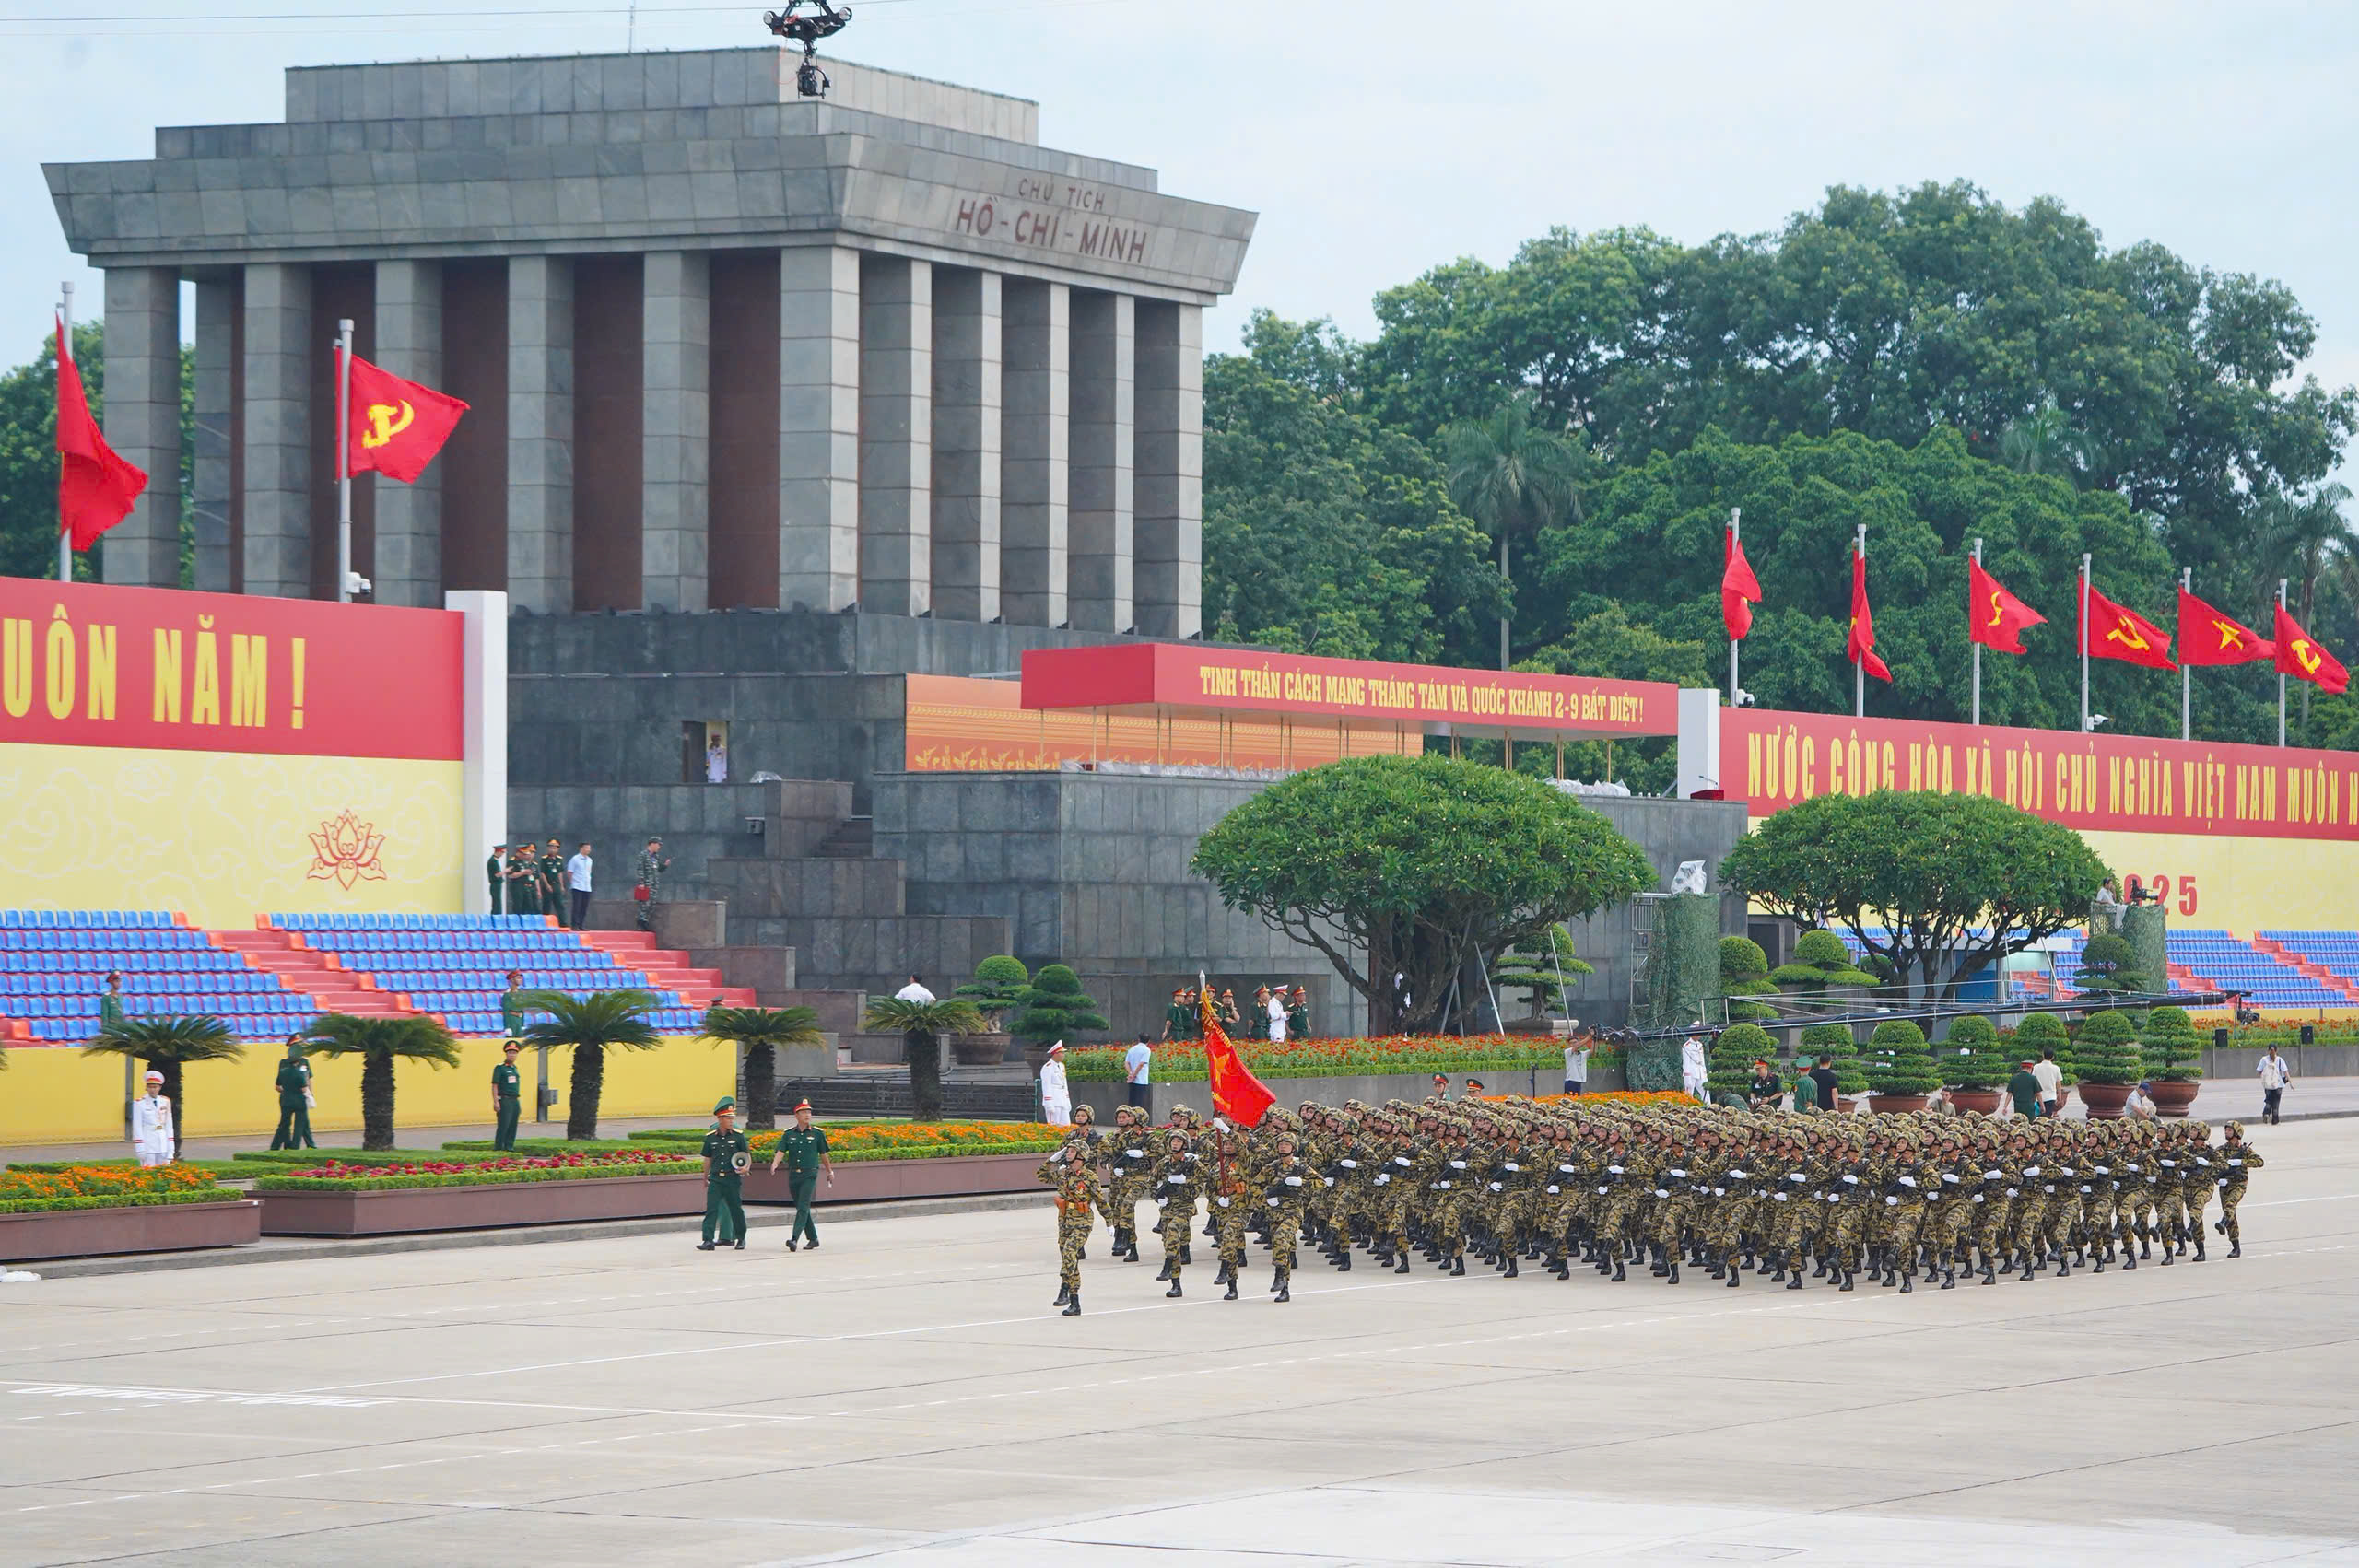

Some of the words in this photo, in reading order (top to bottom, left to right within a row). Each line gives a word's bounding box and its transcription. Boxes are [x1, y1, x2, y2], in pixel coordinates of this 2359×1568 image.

[153, 614, 267, 728] NĂM
[1200, 666, 1238, 696] TINH
[1240, 661, 1281, 699] THẦN
[1285, 668, 1322, 703] CÁCH
[1326, 675, 1366, 709] MẠNG
[1368, 674, 1415, 708] THÁNG
[1418, 678, 1448, 711] TÁM
[1451, 680, 1469, 713] VÀ
[1472, 679, 1506, 716] QUỐC
[1508, 685, 1552, 718] KHÁNH
[1555, 692, 1579, 720] 2-9
[1582, 686, 1607, 720] BẤT
[1747, 723, 1815, 800] NƯỚC
[1909, 733, 1953, 796] HÒA
[1966, 738, 1993, 799] XÃ
[2056, 740, 2097, 813] CHỦ
[2109, 750, 2173, 817] NGHĨA
[2183, 752, 2226, 830] VIỆT
[2236, 765, 2276, 821] NAM
[2287, 759, 2339, 824] MUÔN
